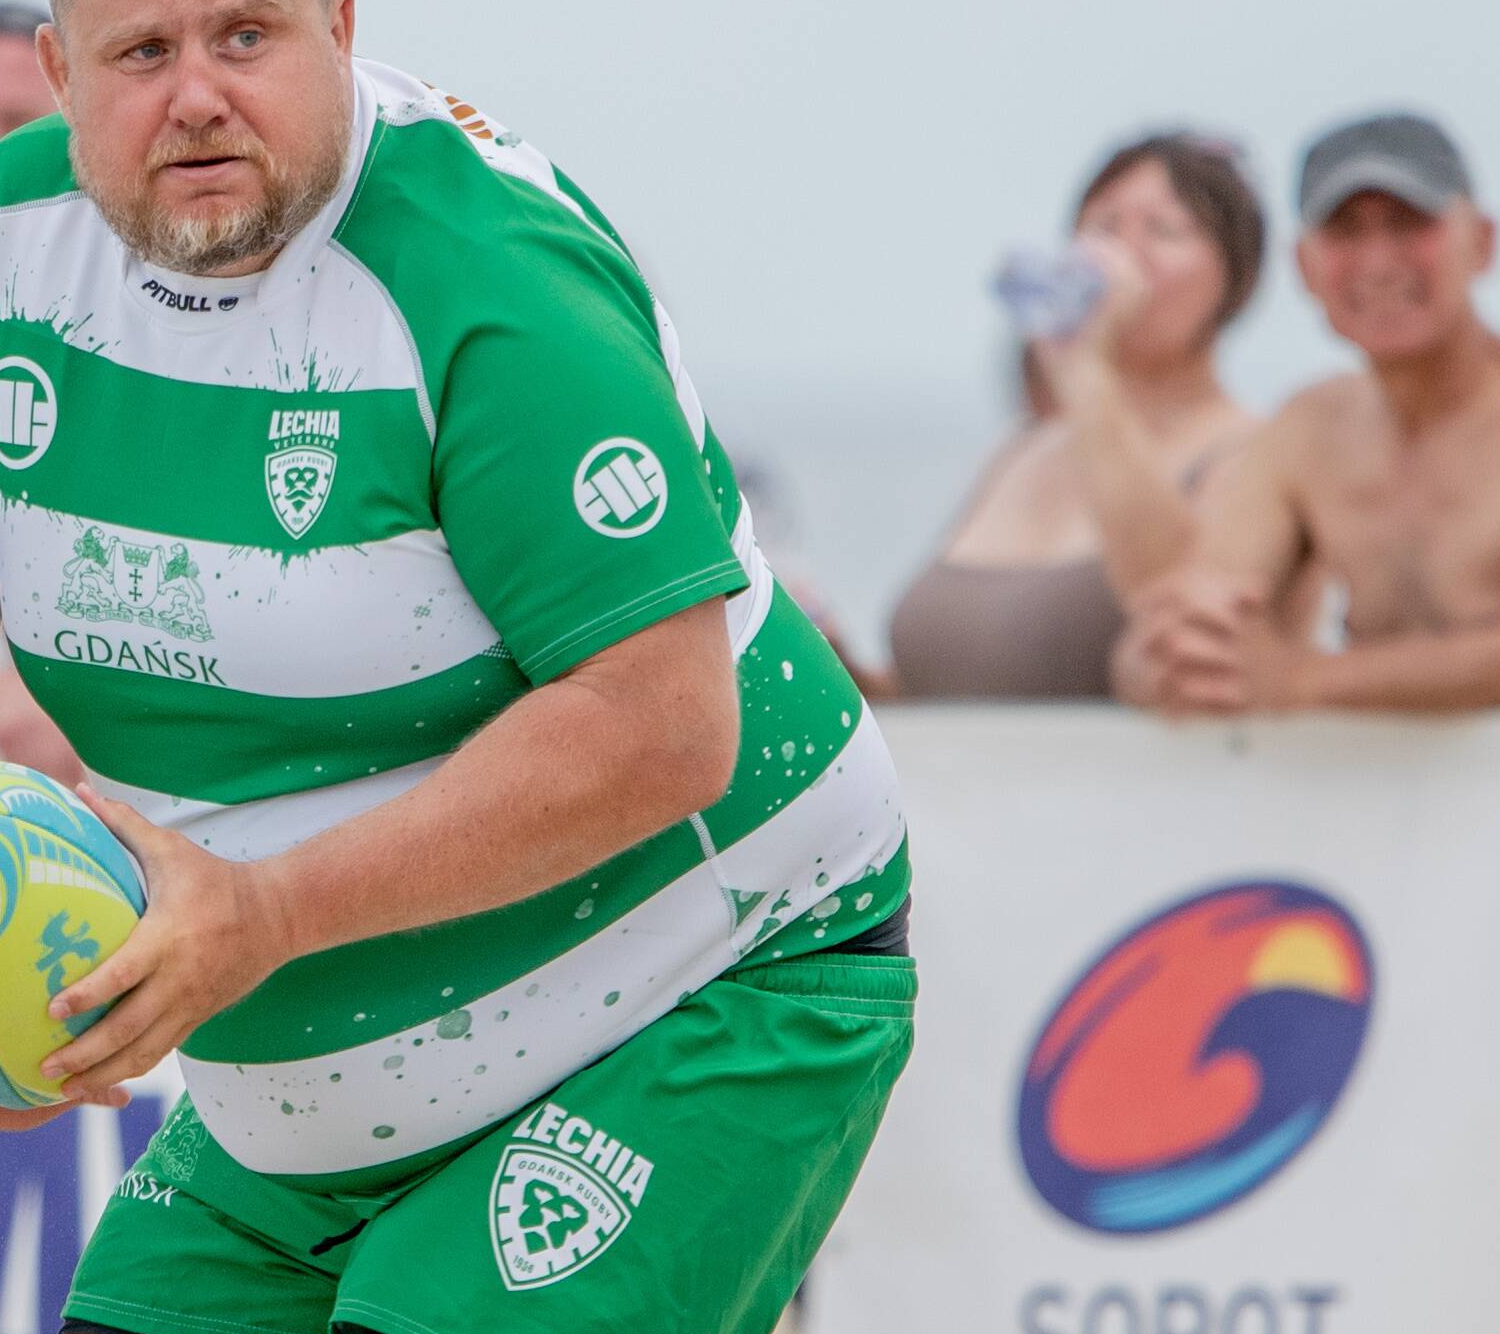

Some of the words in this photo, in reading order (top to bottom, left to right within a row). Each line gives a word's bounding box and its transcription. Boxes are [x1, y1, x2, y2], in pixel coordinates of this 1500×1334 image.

[141, 279, 212, 312] PITBULL
[268, 410, 340, 440] LECHIA
[54, 630, 227, 686] GDAŃSK
[576, 1183, 612, 1220] RUGBY
